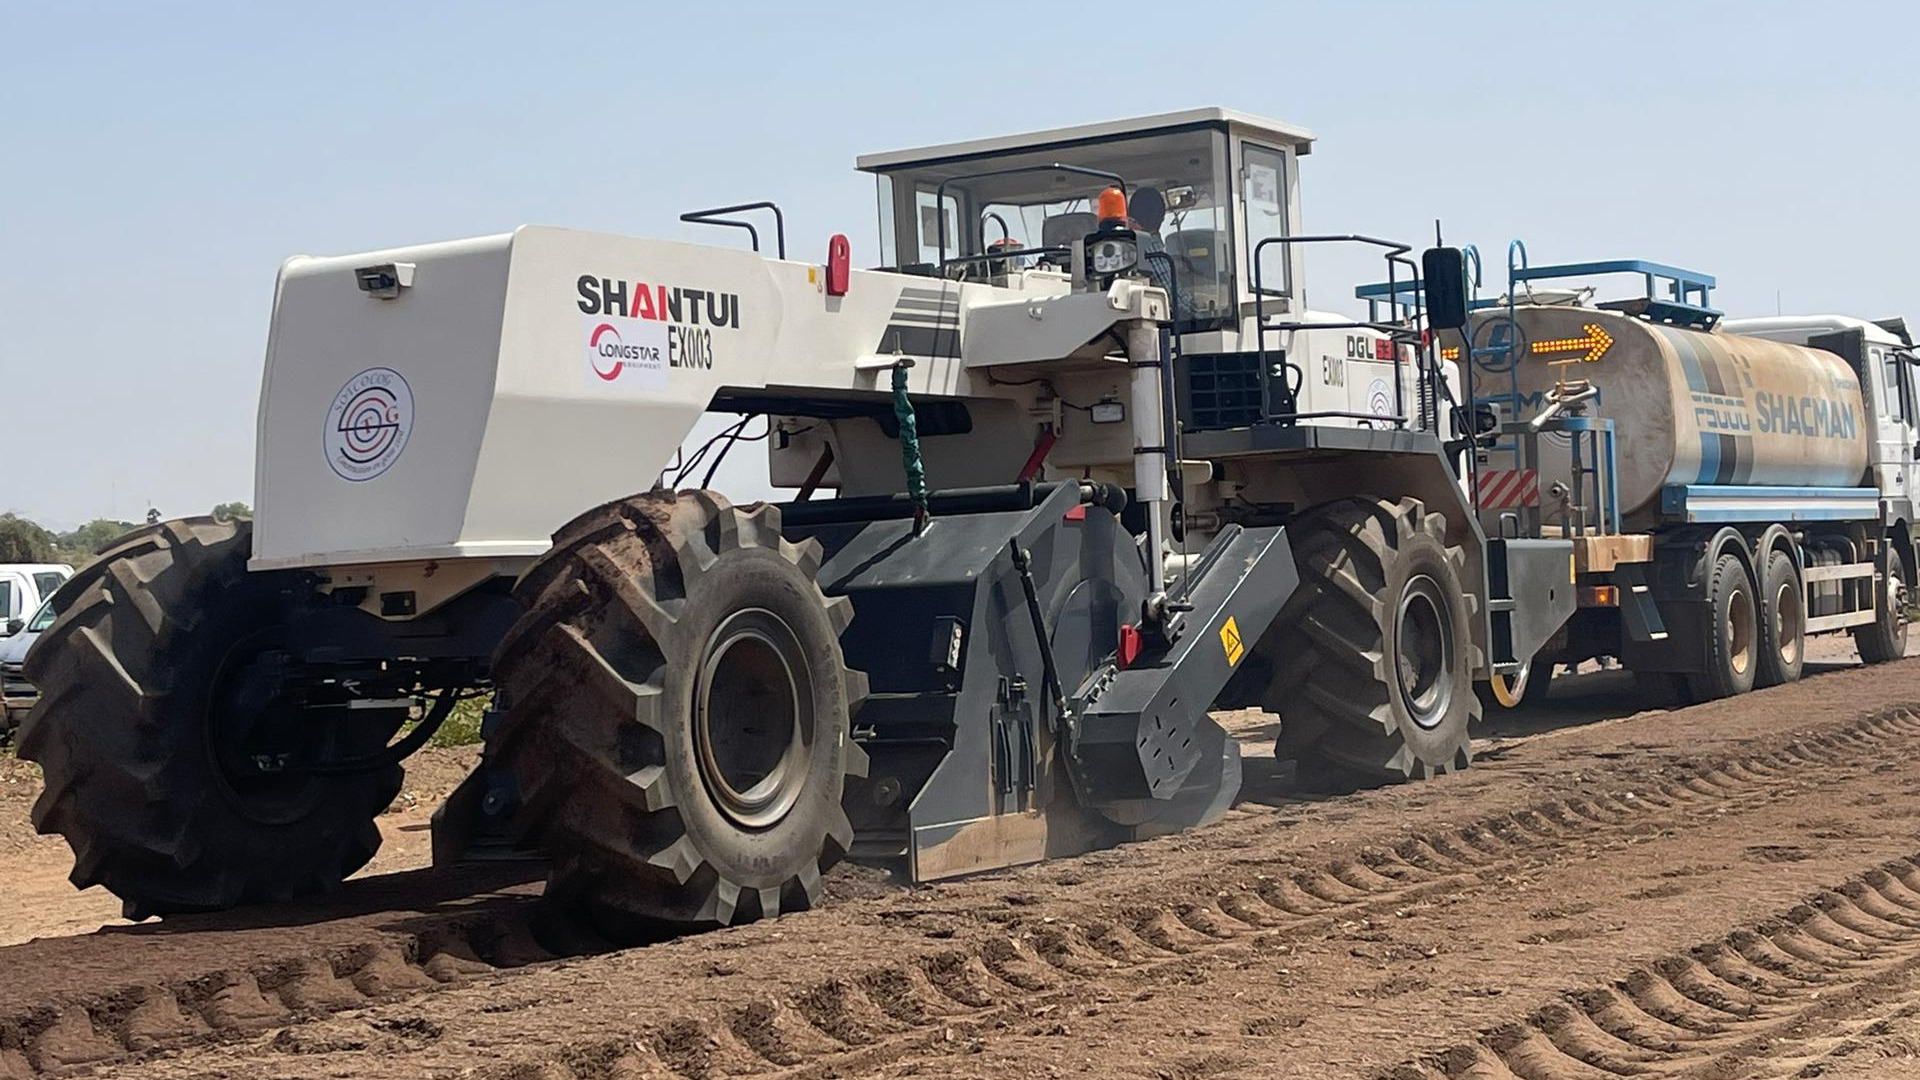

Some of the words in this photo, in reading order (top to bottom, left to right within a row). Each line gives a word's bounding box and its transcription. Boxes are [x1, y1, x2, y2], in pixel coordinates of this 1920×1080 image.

[577, 275, 739, 328] SHANTUI
[598, 343, 660, 361] LONGSTAR
[668, 325, 712, 370] EX003
[1347, 335, 1374, 359] DGL
[1755, 391, 1856, 439] SHACMAN
